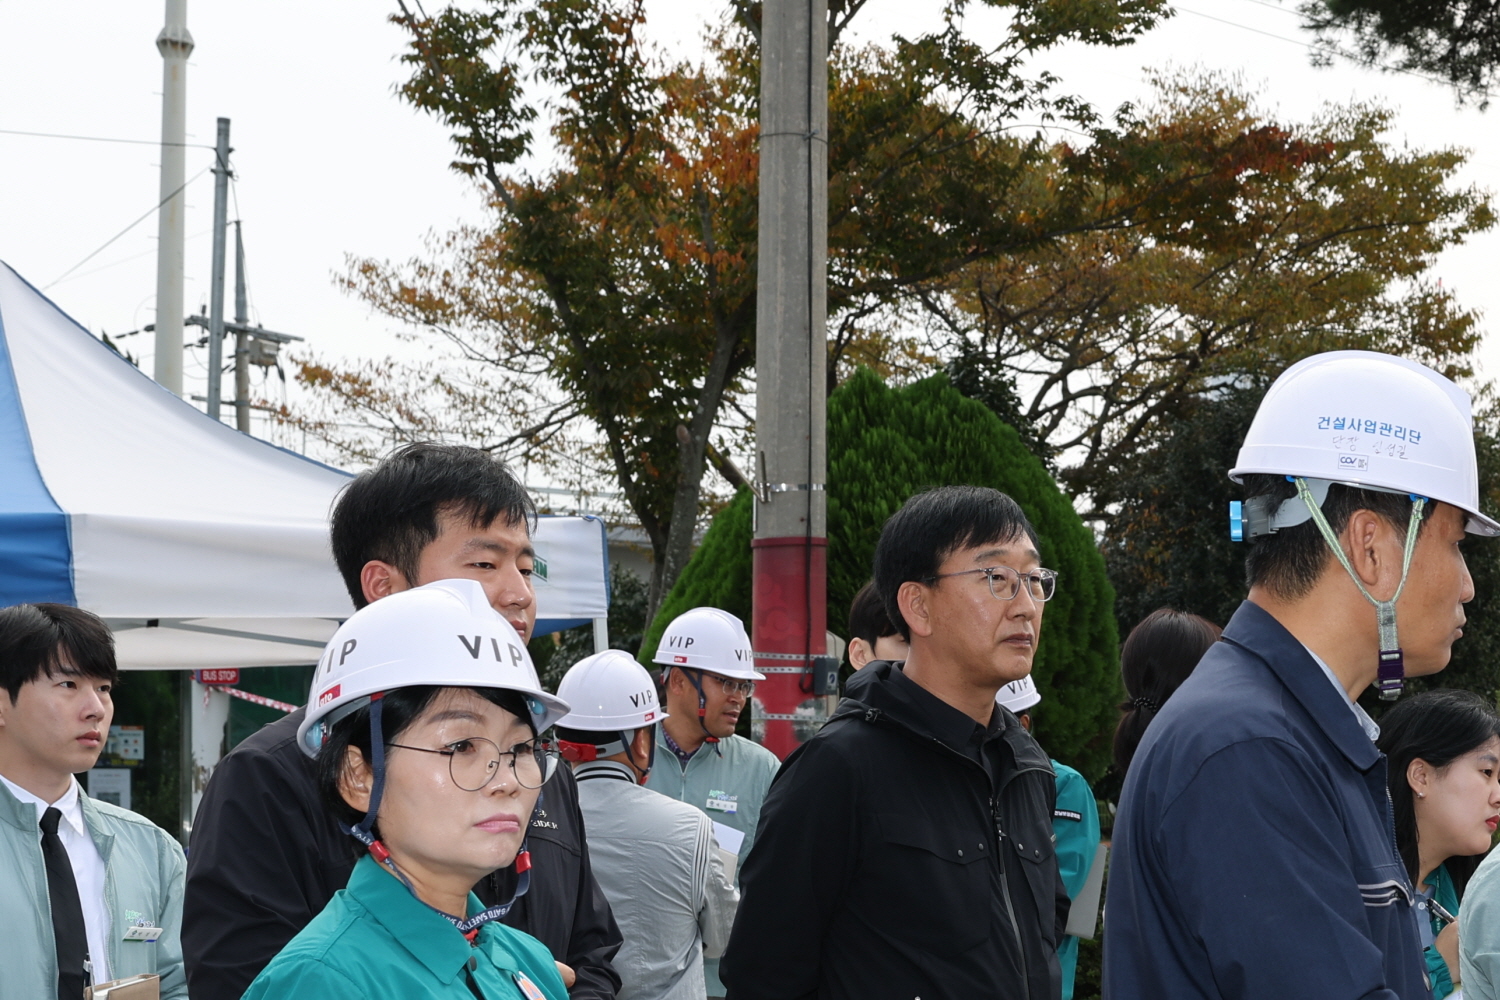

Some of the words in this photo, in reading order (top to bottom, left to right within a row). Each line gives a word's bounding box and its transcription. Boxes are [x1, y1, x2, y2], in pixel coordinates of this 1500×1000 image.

[1317, 416, 1421, 445] 건설사업관리단
[457, 634, 523, 667] VIP
[669, 636, 695, 649] VIP
[202, 670, 217, 681] BUS
[218, 670, 237, 681] STOP
[1007, 678, 1028, 694] VIP
[629, 689, 653, 708] VIP
[488, 907, 506, 919] SATO
[464, 913, 488, 931] SAFETY
